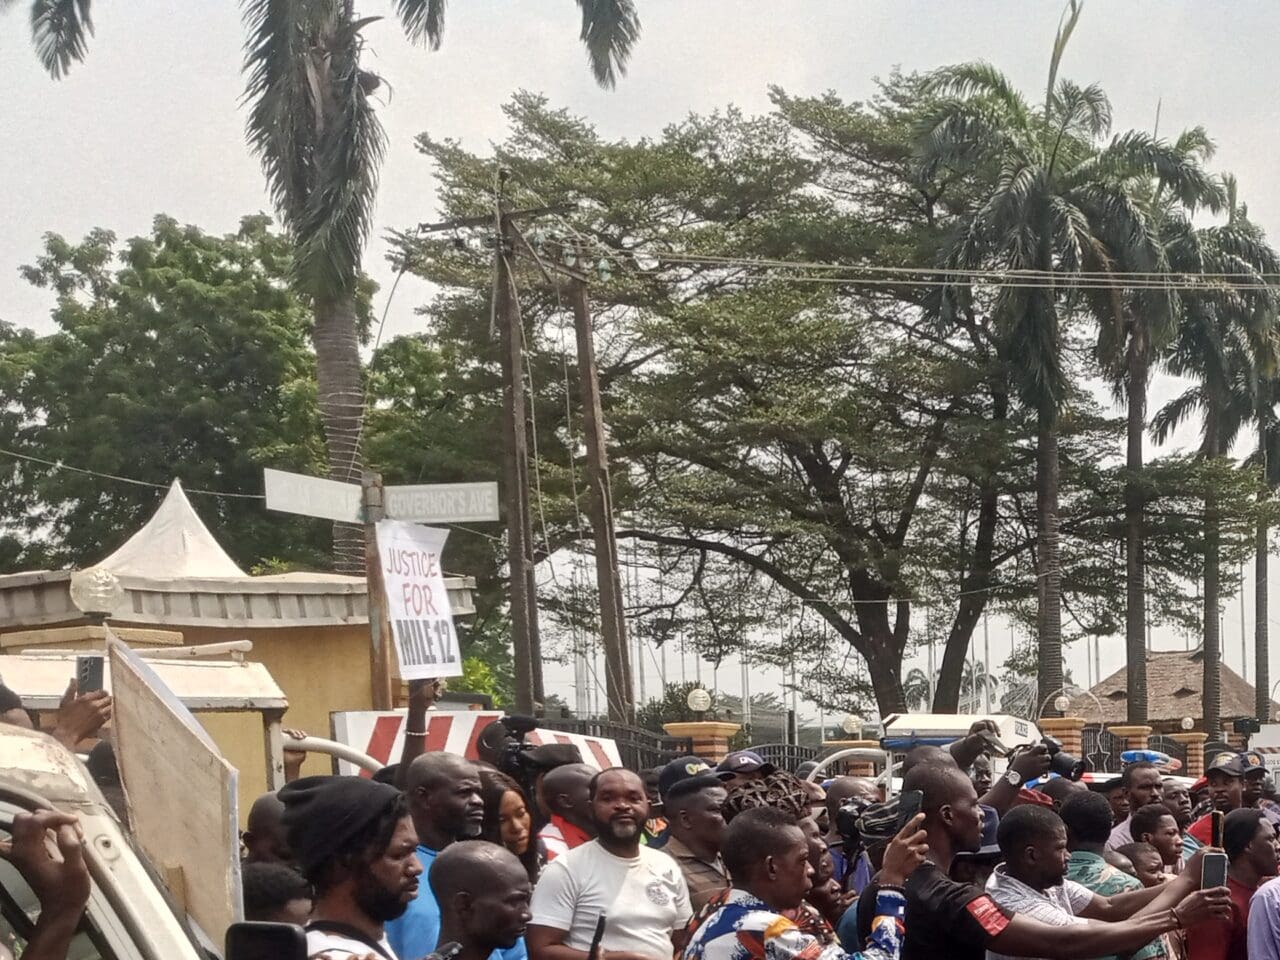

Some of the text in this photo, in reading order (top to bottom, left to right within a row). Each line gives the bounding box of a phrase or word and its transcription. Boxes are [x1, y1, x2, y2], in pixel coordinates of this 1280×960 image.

[388, 490, 466, 516] GOVERNOR'S
[469, 489, 493, 513] AVE
[387, 547, 437, 577] JUSTICE
[402, 583, 438, 616] FOR
[396, 619, 455, 666] MILE 12
